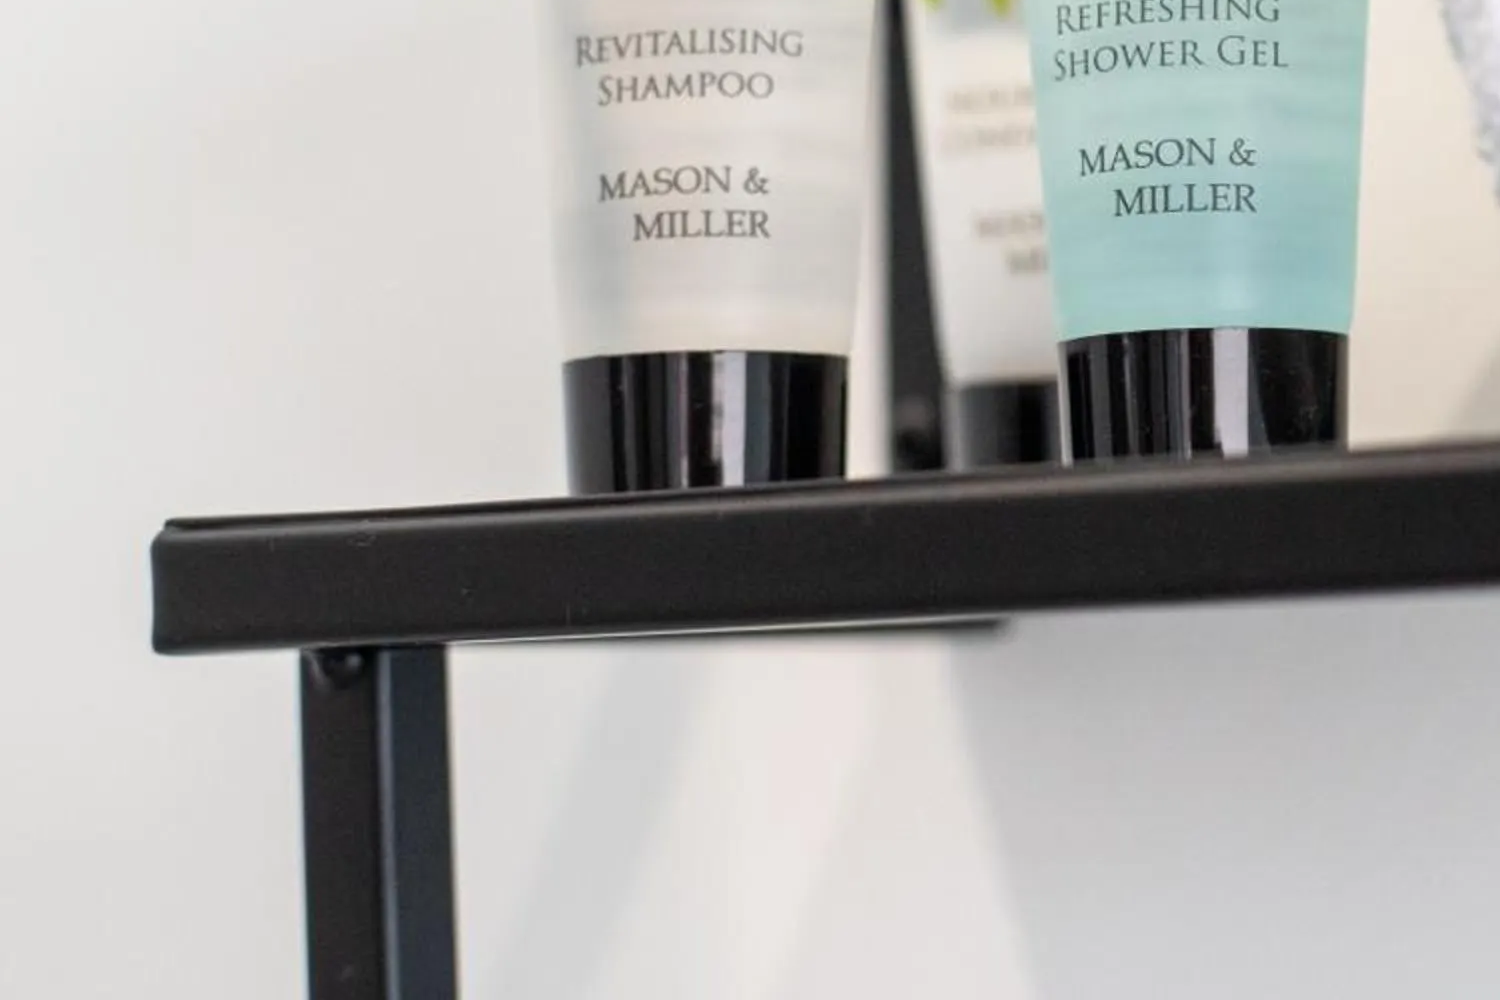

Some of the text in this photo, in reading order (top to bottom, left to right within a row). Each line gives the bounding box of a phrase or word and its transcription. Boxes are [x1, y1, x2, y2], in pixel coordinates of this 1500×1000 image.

[576, 28, 803, 67] REVITALISING
[1054, 35, 1289, 81] SHOWER GEL
[598, 71, 774, 106] SHAMPOO
[1079, 138, 1257, 176] MASON &
[599, 165, 769, 202] MASON &
[1113, 183, 1257, 217] MILLER
[633, 210, 770, 241] MILLER
